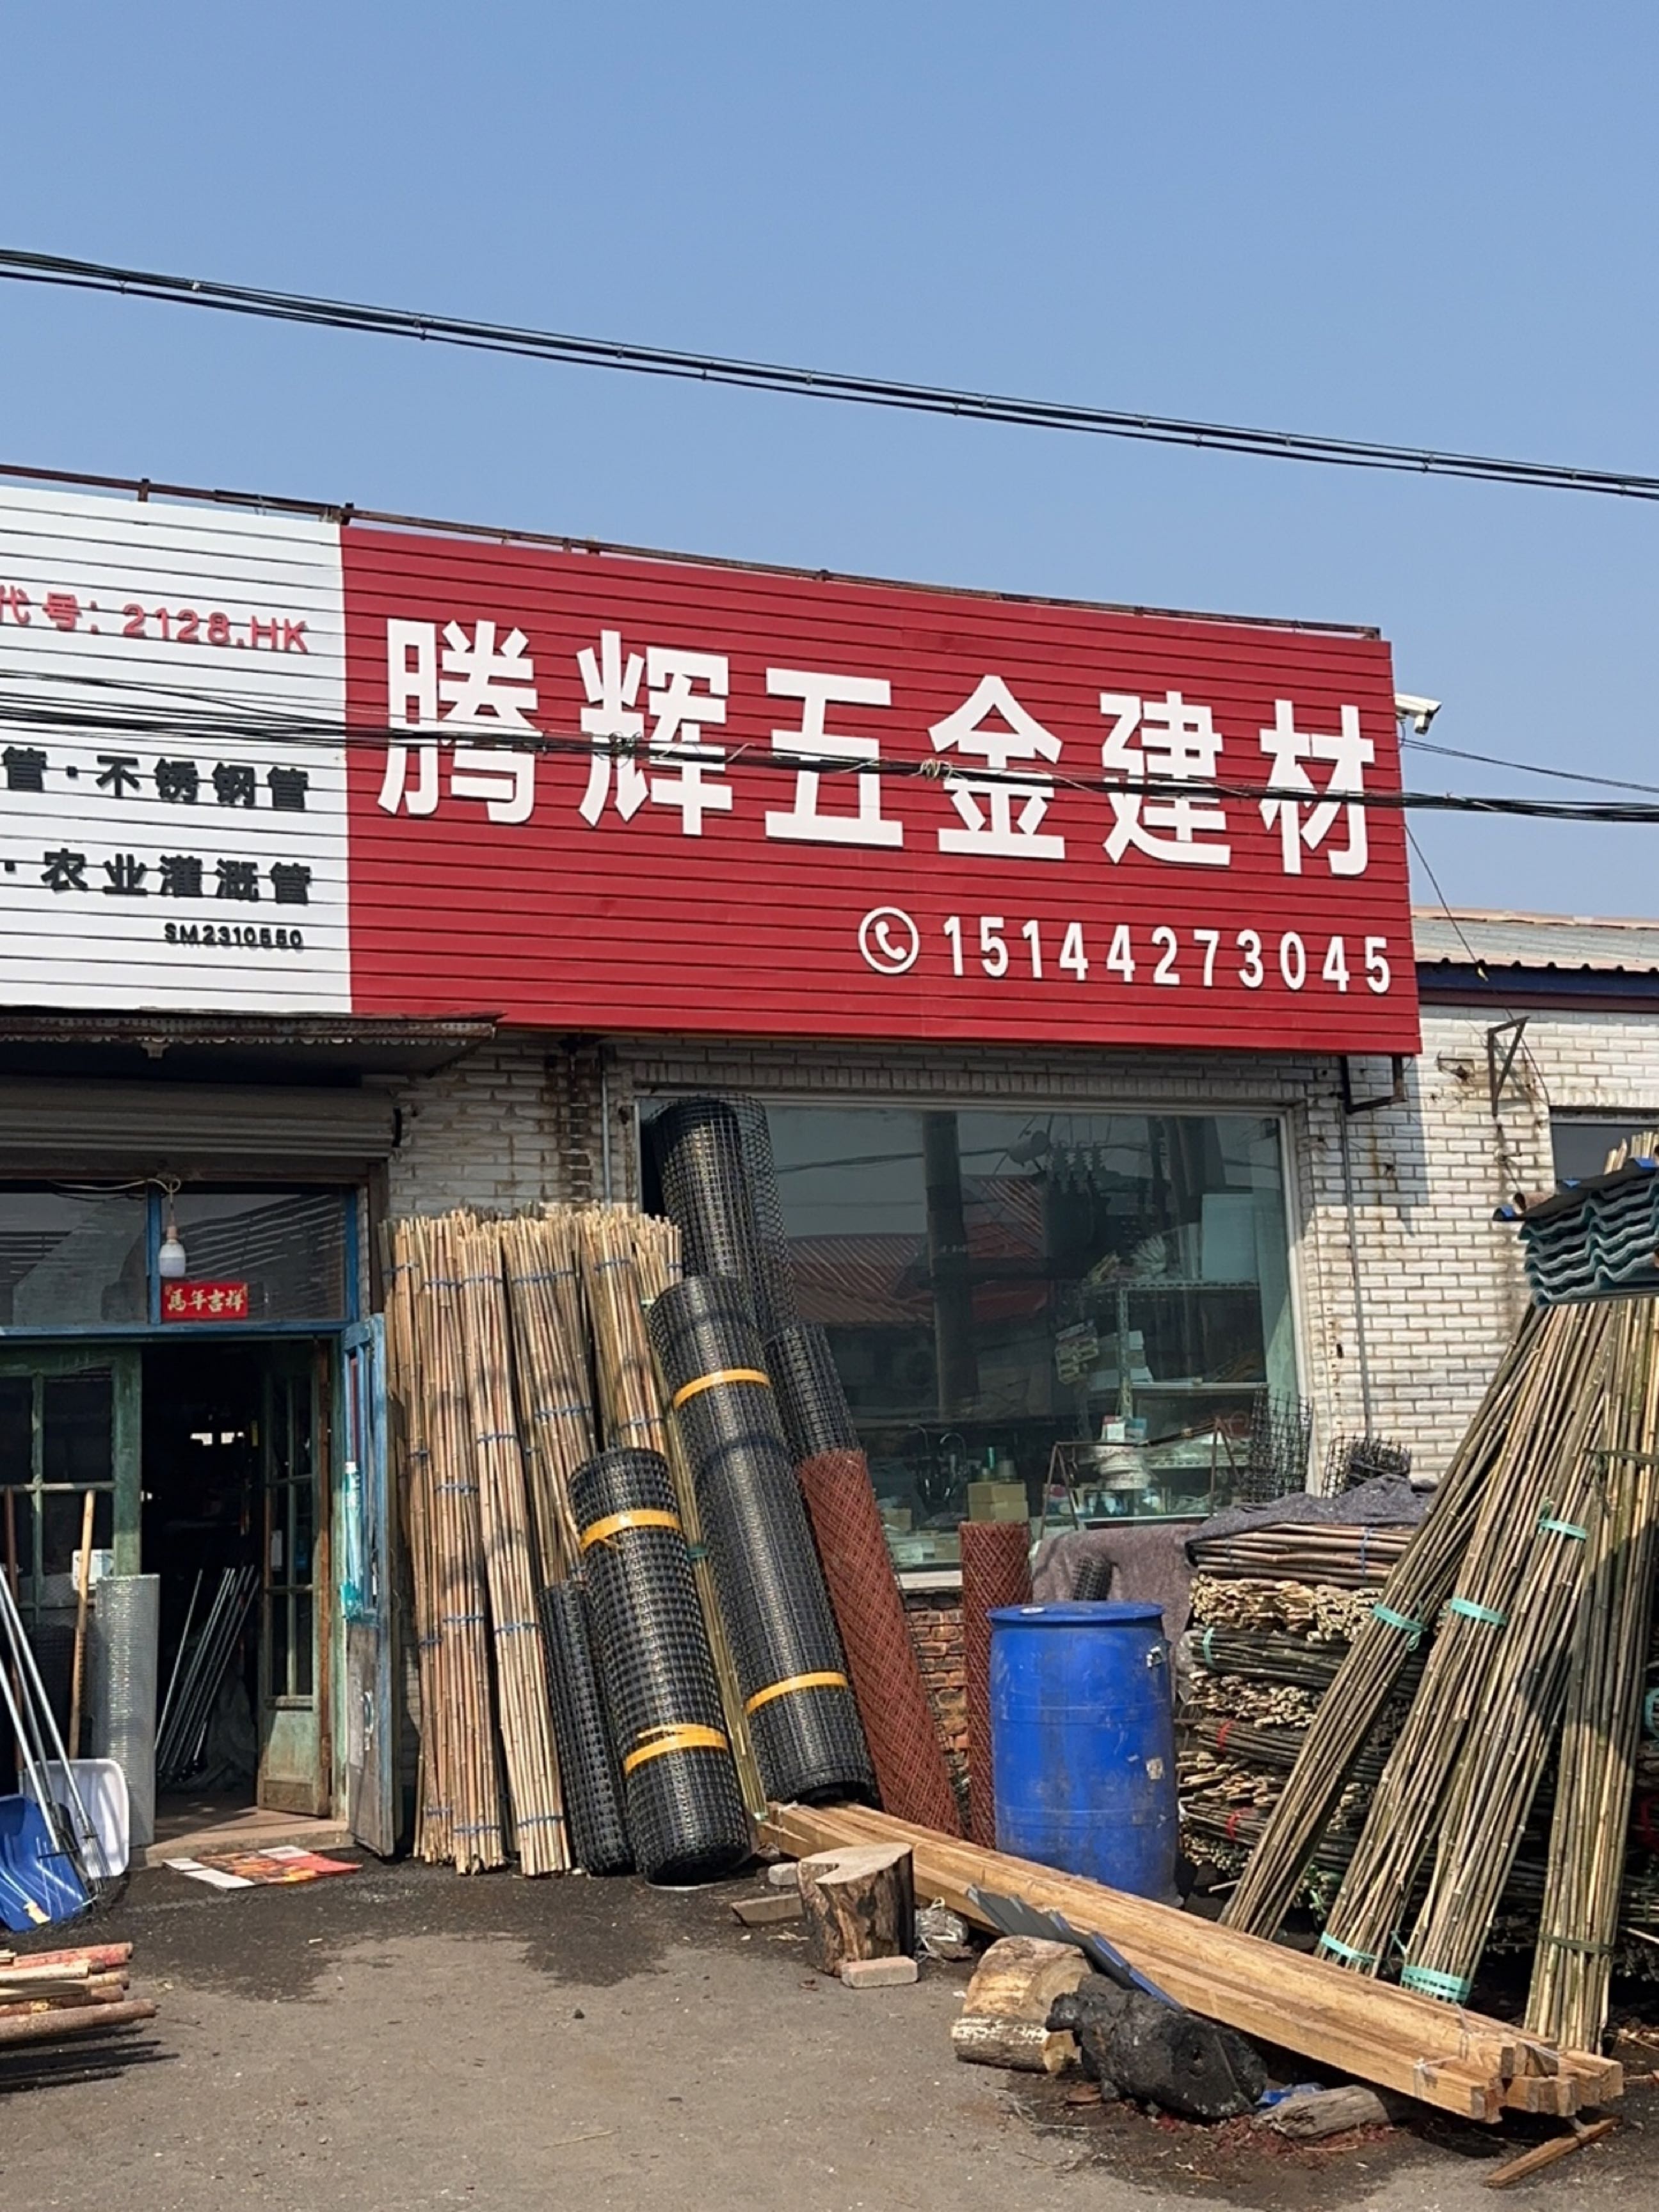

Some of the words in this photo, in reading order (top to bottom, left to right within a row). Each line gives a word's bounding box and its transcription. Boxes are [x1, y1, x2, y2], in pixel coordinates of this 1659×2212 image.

[377, 618, 1374, 876] 腾辉五金建材
[164, 922, 303, 951] SM2310550
[943, 916, 1390, 993] 15144273045
